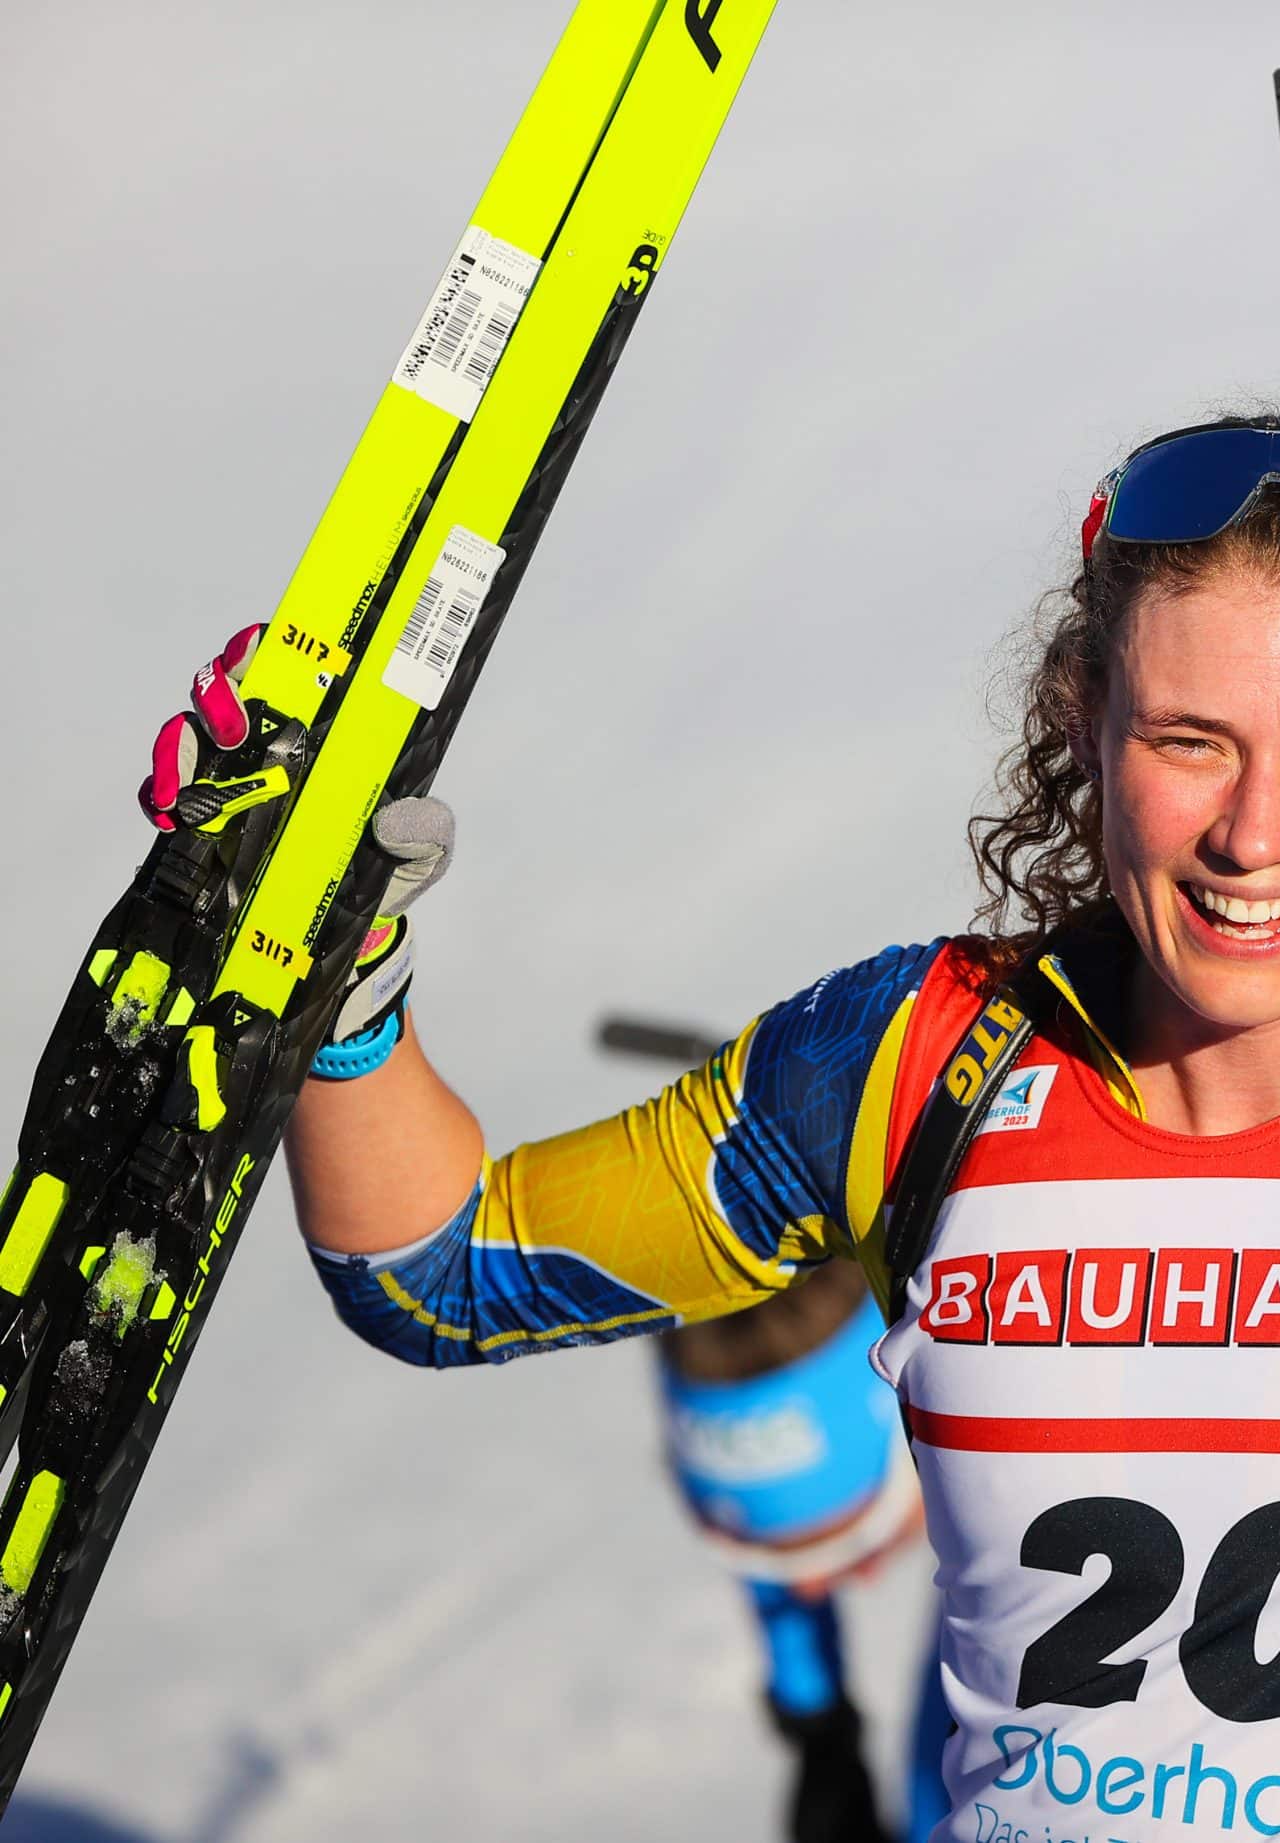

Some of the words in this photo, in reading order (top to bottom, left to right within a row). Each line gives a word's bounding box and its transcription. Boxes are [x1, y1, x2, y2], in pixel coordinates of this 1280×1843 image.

[620, 244, 660, 297] 3D
[338, 579, 378, 650] speedmax
[281, 623, 331, 663] 3117
[302, 878, 340, 948] speedmax
[250, 930, 295, 968] 3117
[945, 999, 1026, 1106] ATG
[987, 1104, 1032, 1119] BERHOF
[1003, 1115, 1029, 1127] 2023
[147, 1153, 255, 1404] FISCHER
